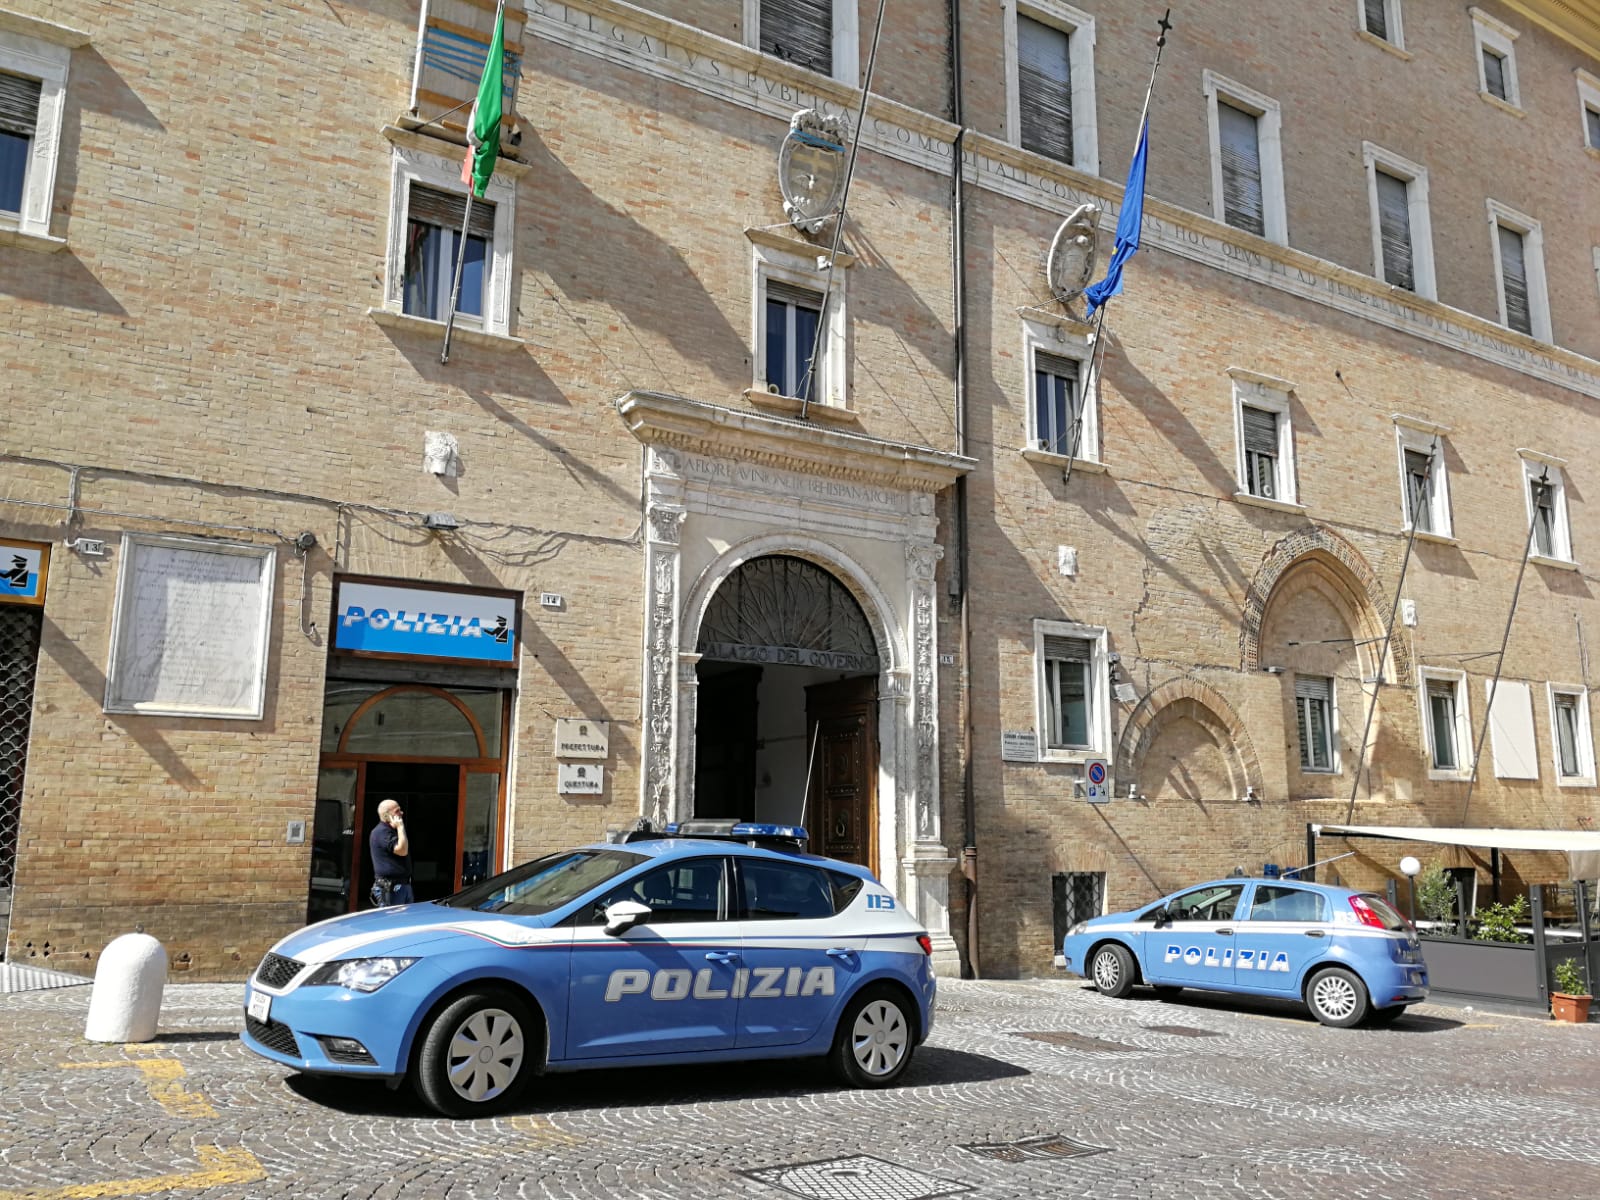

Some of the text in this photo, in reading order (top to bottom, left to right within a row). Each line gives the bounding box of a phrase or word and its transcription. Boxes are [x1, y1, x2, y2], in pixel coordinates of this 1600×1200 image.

[746, 71, 867, 127] PVBLICA
[1039, 176, 1162, 235] CONSVLNS
[342, 605, 483, 639] POLIZIA
[699, 642, 875, 670] PALAZZO DEL GOVERNO
[564, 780, 599, 790] QUESTURA
[865, 893, 896, 911] 113
[1164, 944, 1291, 973] POLIZIA
[604, 966, 835, 1002] POLIZIA
